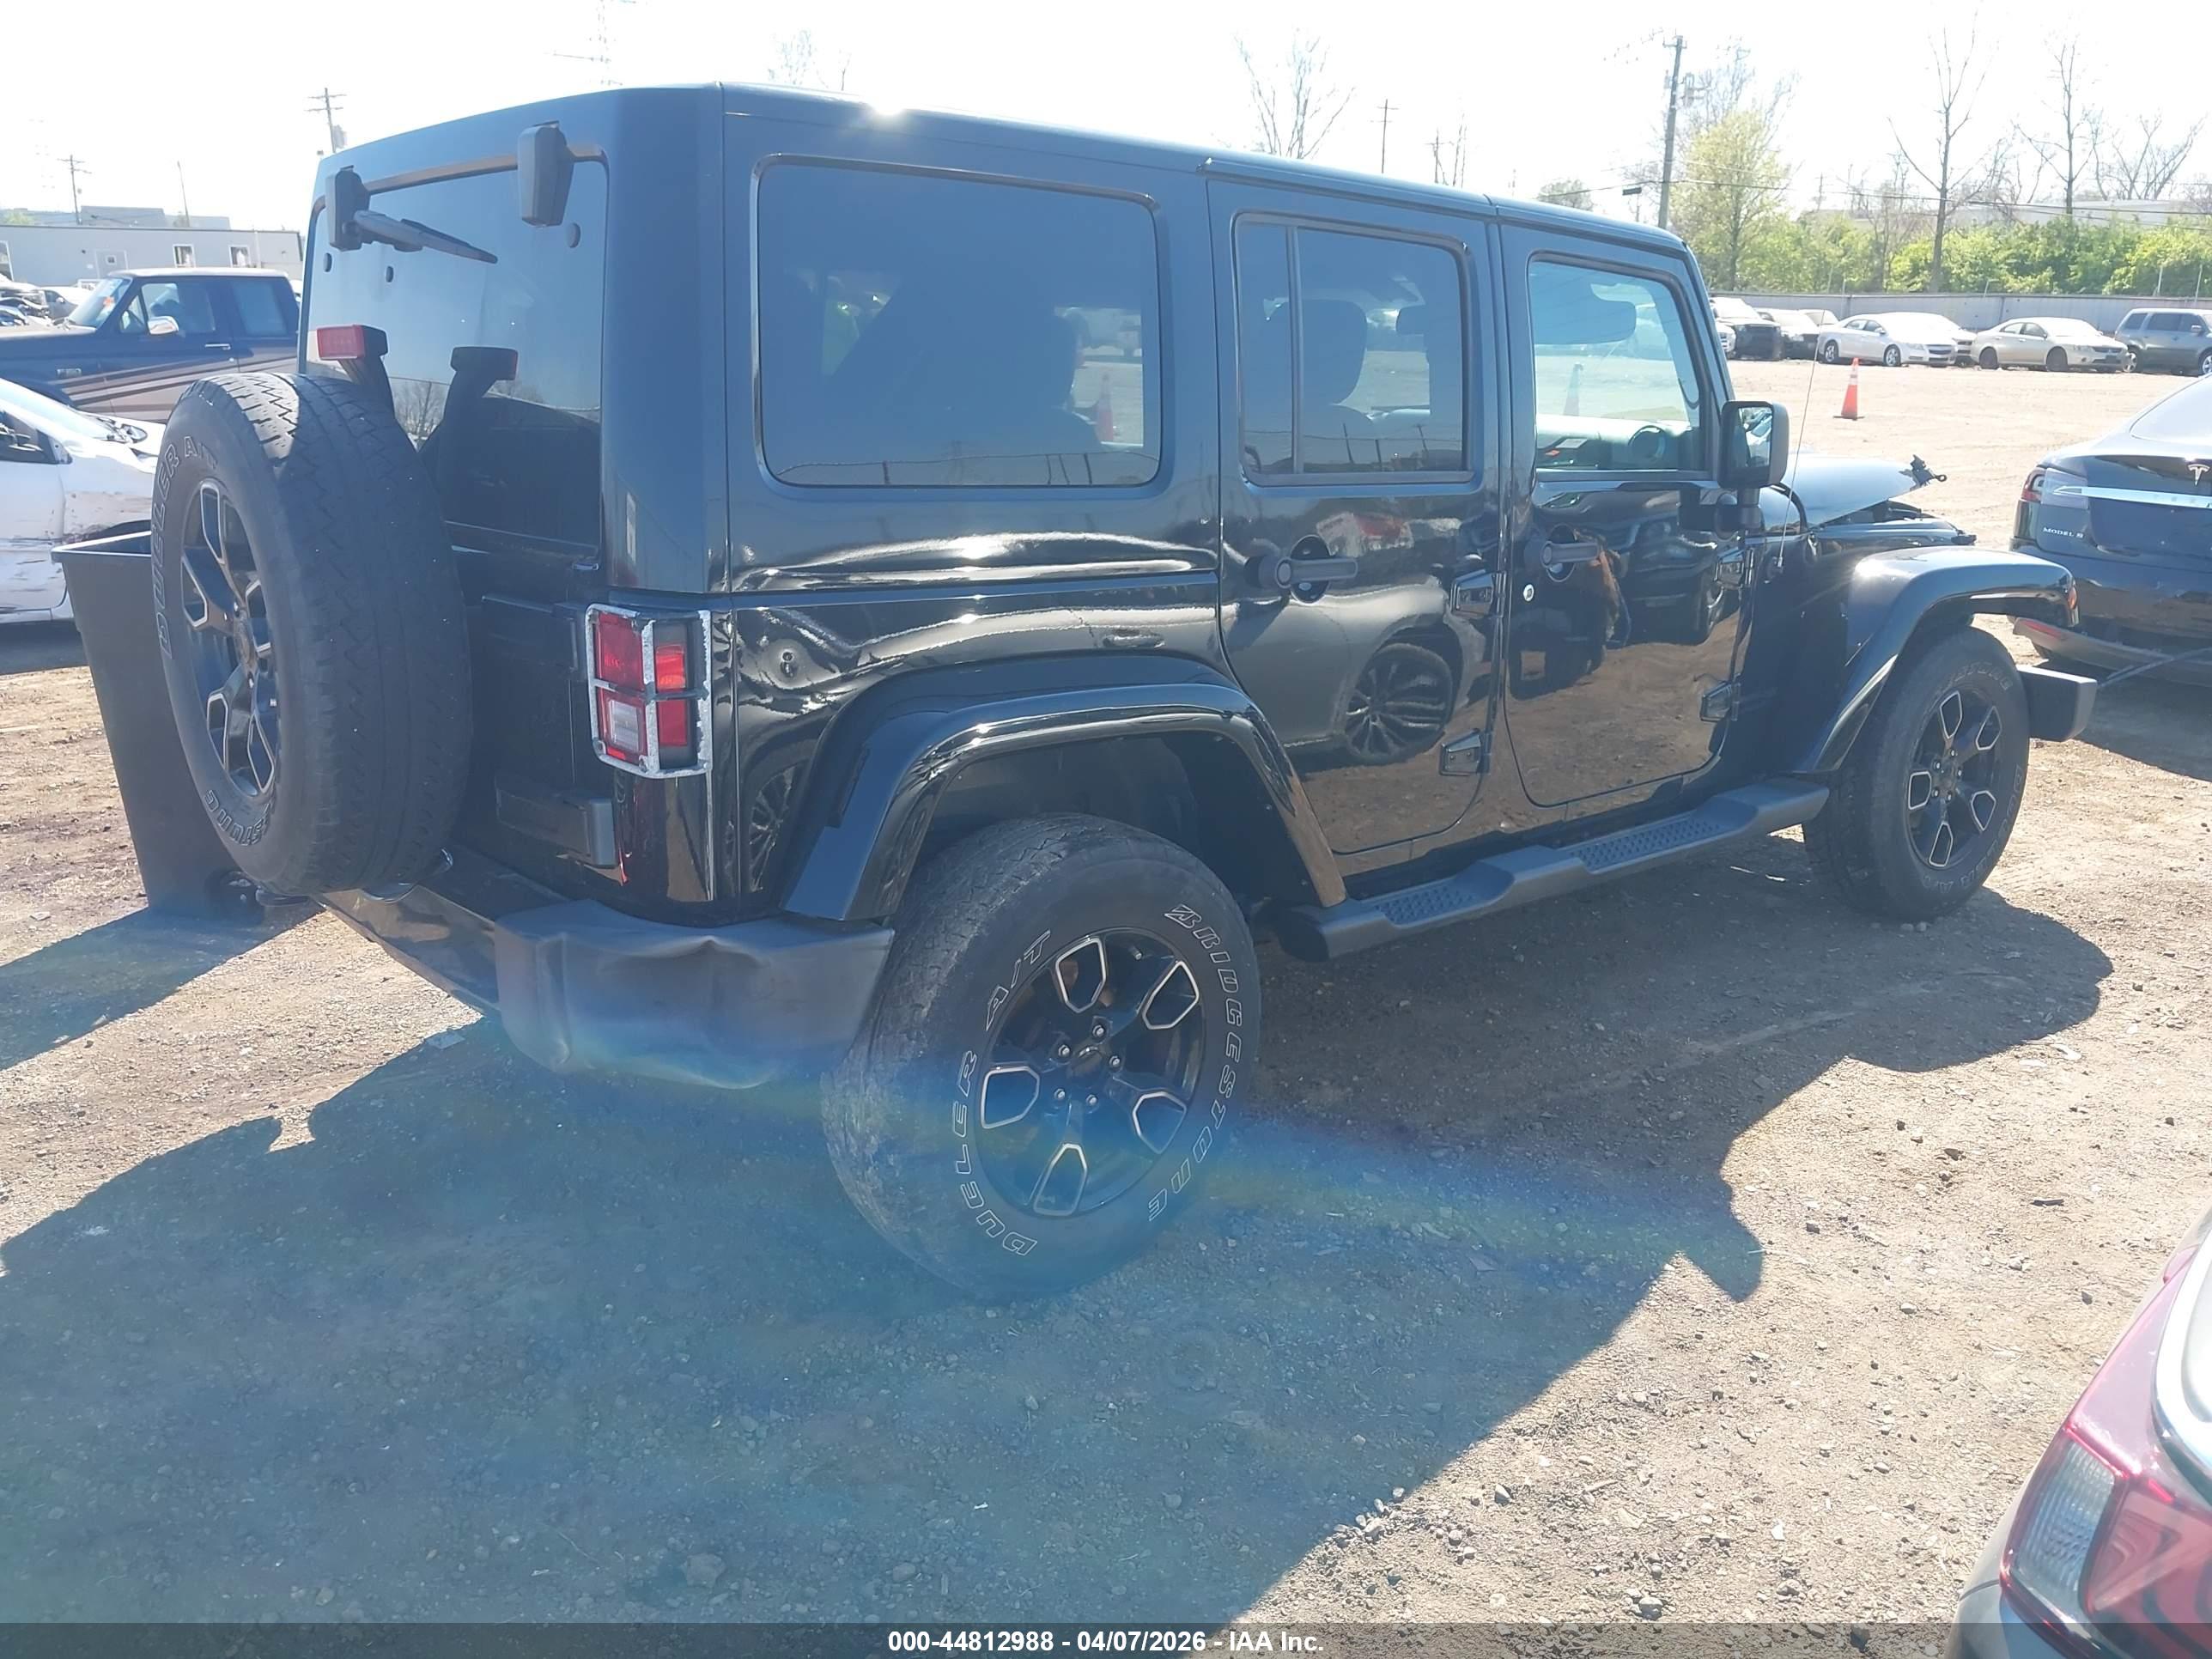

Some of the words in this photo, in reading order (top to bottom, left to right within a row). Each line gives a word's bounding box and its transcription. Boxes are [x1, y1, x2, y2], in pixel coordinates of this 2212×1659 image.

[150, 443, 179, 659] DUELER
[2043, 526, 2074, 537] MODEL
[985, 929, 1052, 1032] A/T
[1147, 902, 1243, 1222] BRIDGESTONE
[951, 1049, 1039, 1257] DUELER
